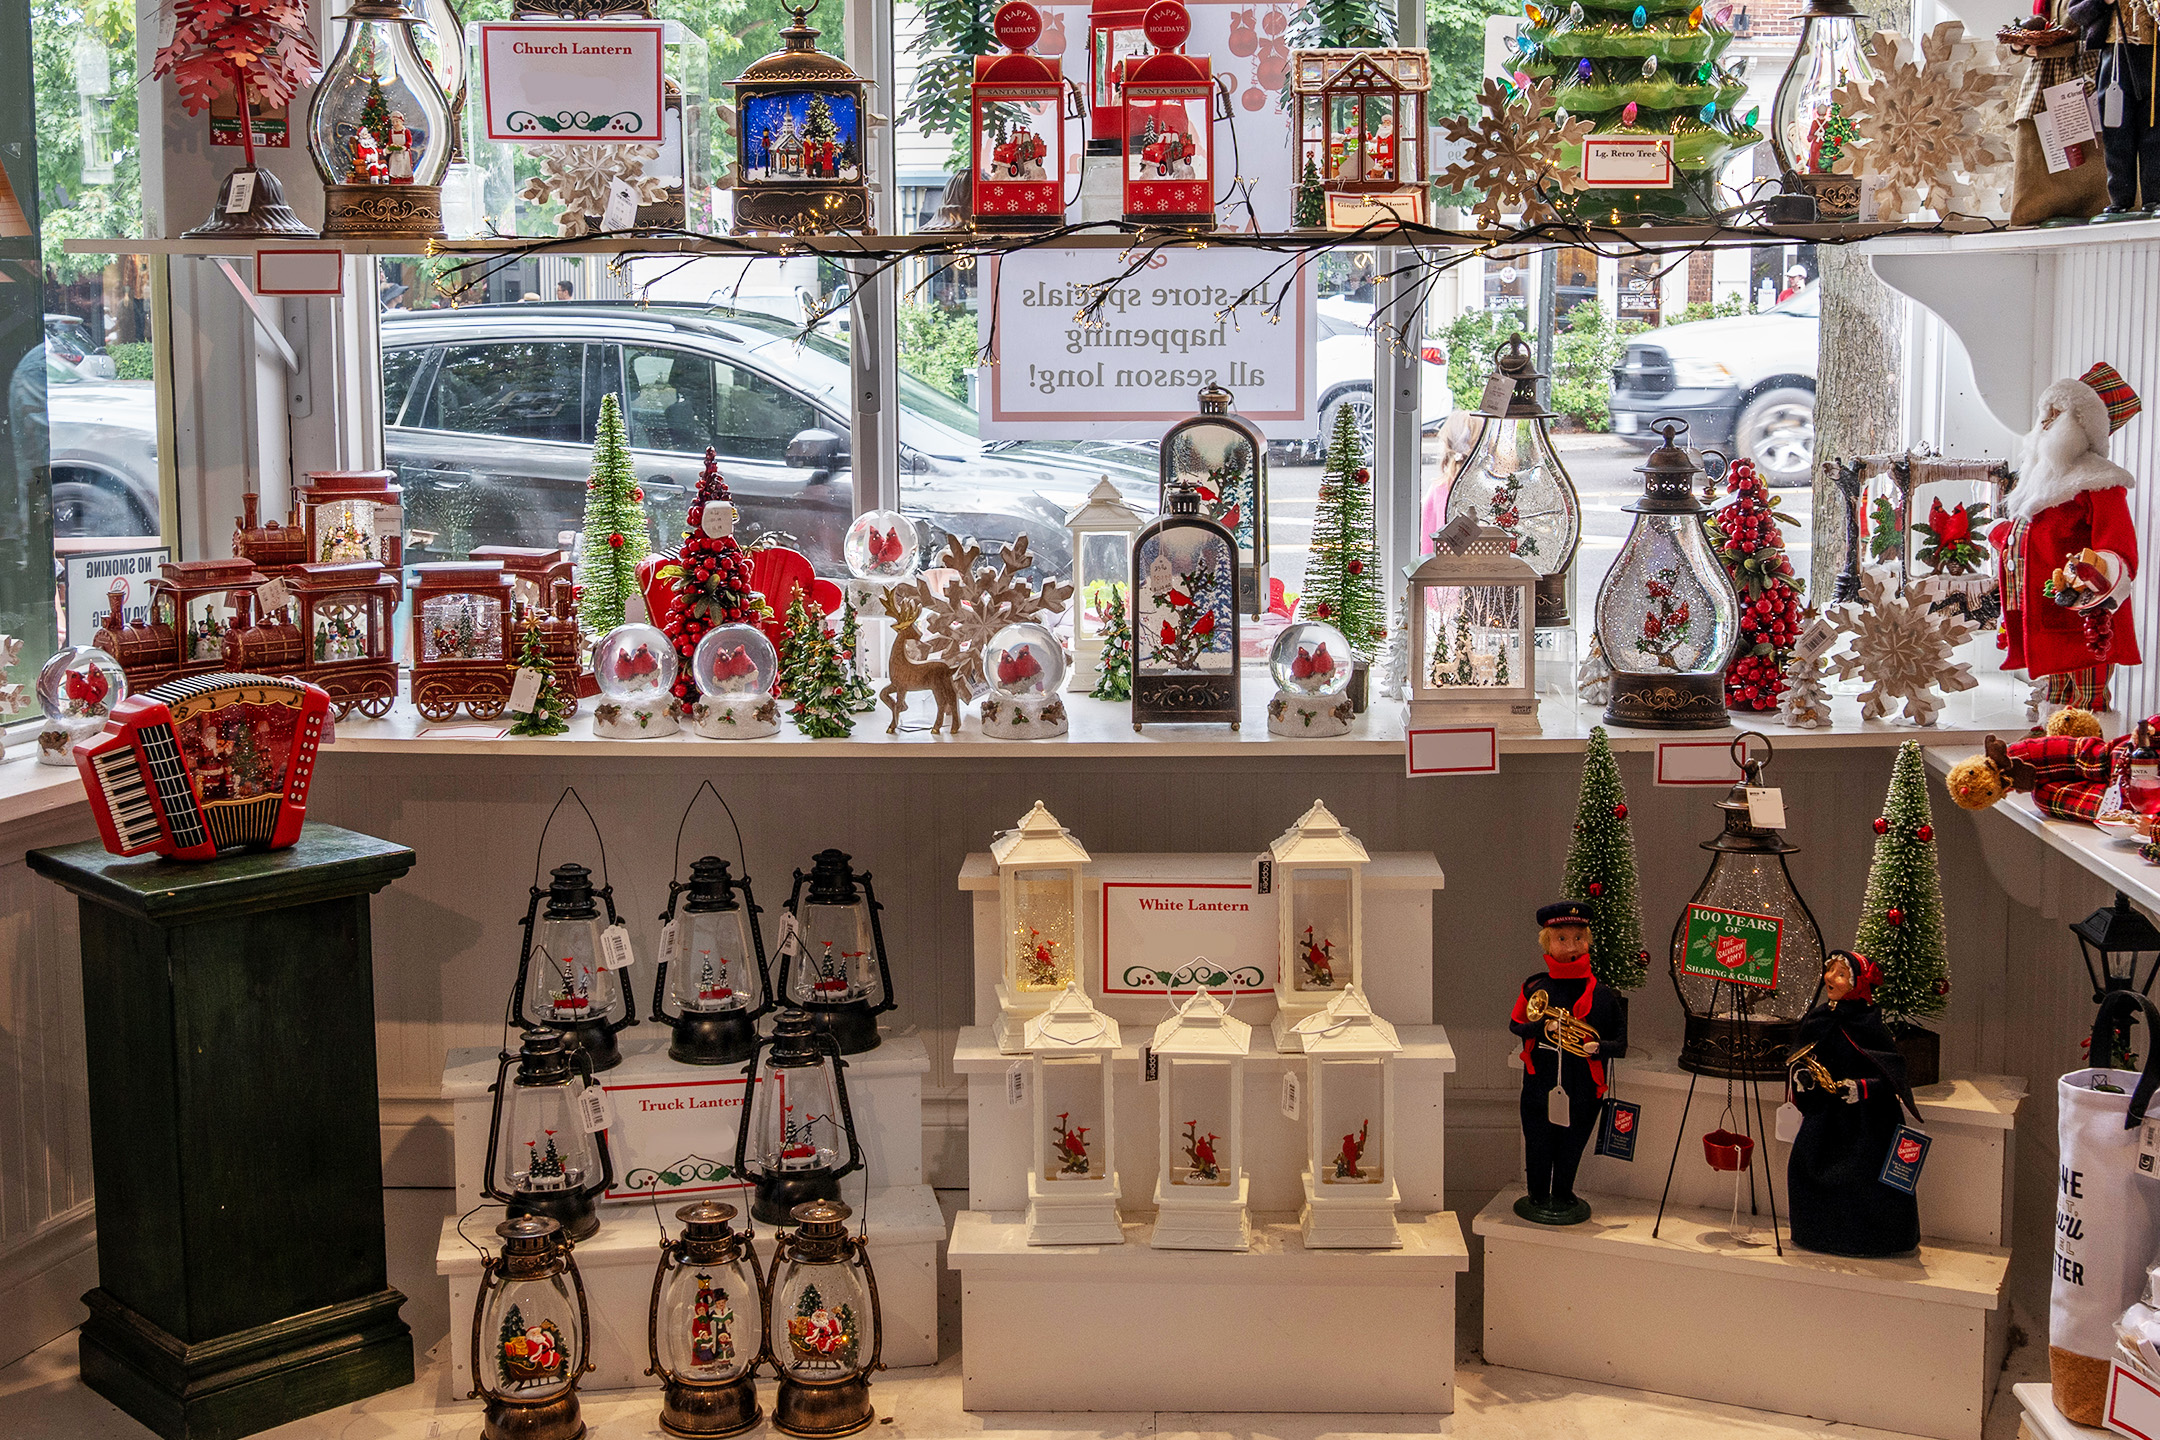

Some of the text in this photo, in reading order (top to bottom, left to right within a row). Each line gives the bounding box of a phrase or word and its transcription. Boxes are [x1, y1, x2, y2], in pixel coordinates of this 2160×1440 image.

[1004, 9, 1032, 22] HAPPY
[1153, 9, 1182, 22] HAPPY
[512, 42, 633, 55] Church Lantern
[1595, 150, 1608, 159] Lg.
[1262, 861, 1270, 893] Koppers
[1138, 898, 1249, 911] White Lantern
[1693, 909, 1777, 932] 100 YEARS
[1725, 926, 1742, 934] OF
[1722, 938, 1735, 948] THE
[1717, 942, 1745, 959] SALVATION
[1725, 951, 1743, 964] ARMY
[1686, 964, 1727, 979] SHARING
[1737, 972, 1771, 985] CARING
[638, 1098, 685, 1112] Truck
